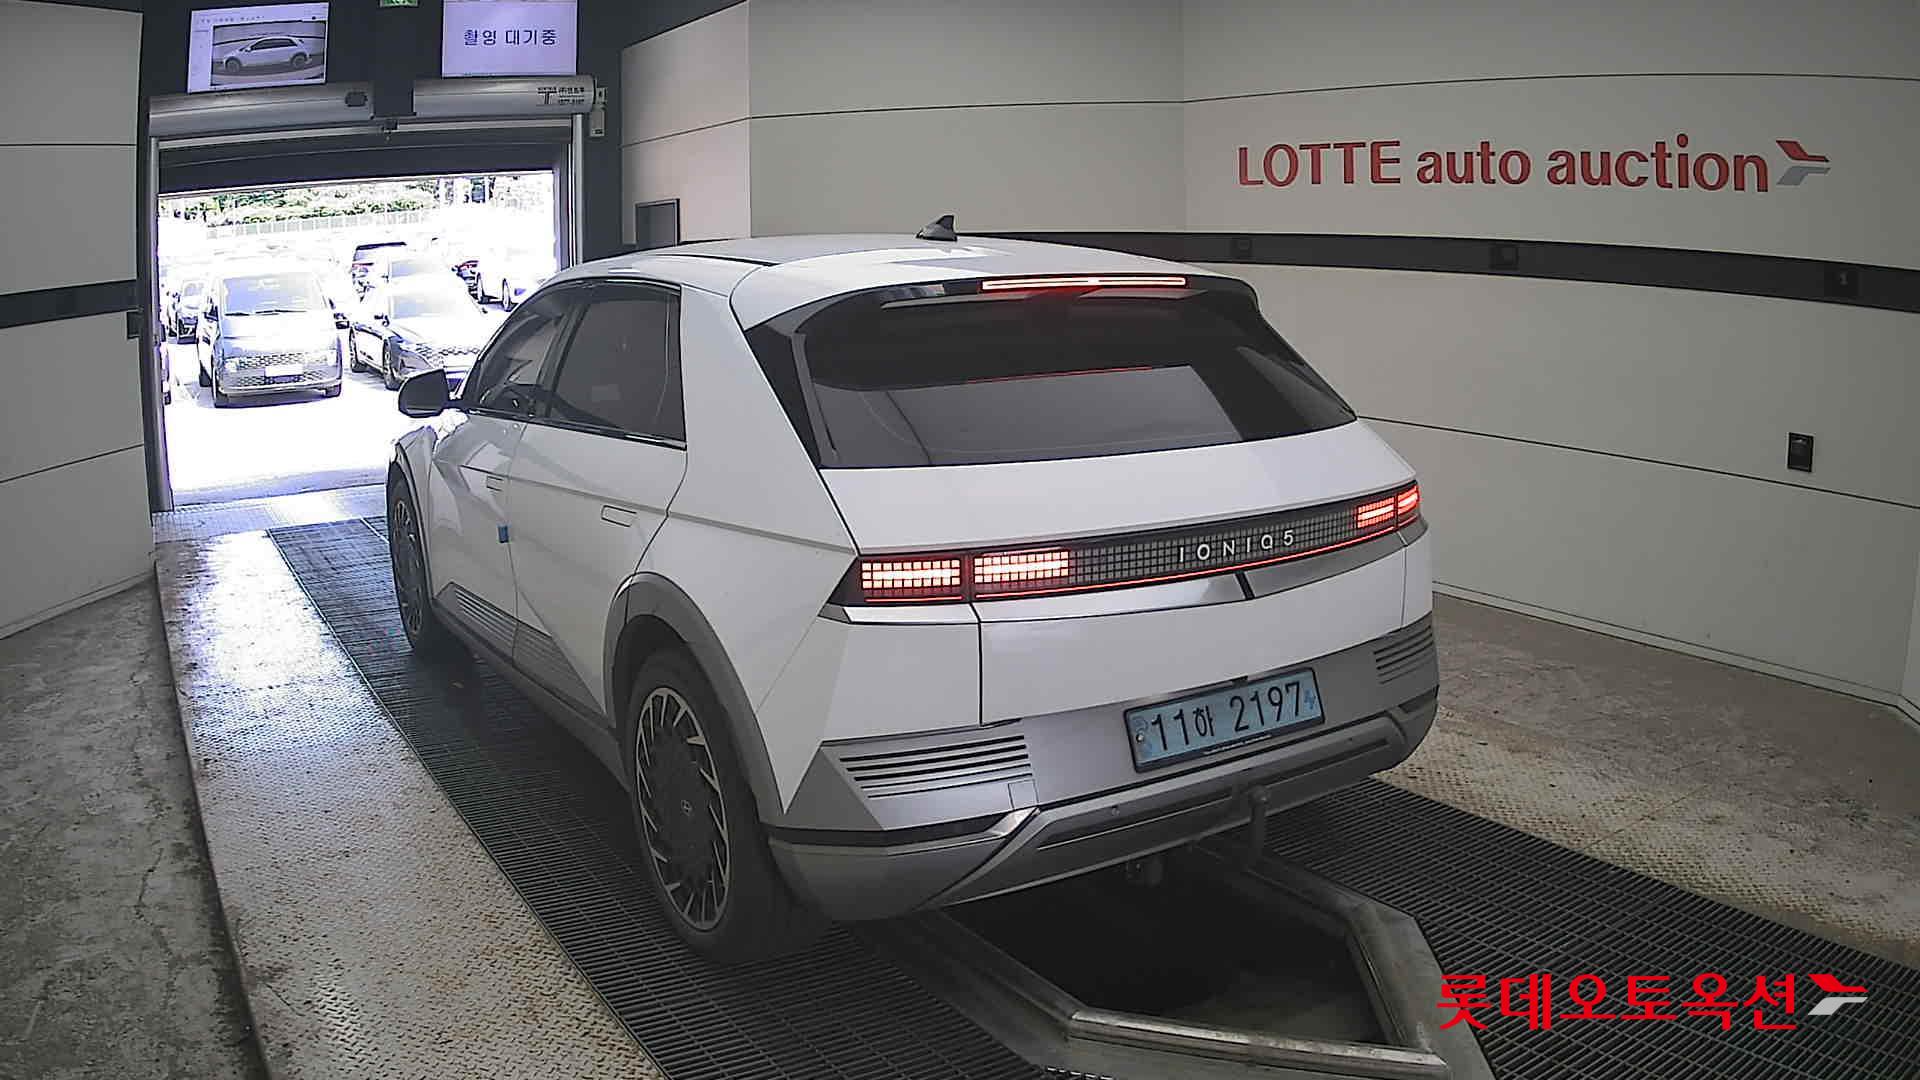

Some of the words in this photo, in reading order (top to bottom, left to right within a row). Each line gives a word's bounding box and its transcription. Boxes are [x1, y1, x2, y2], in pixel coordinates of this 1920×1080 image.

[505, 29, 557, 46] 대기중
[1238, 141, 1401, 186] LOTTE
[1416, 140, 1532, 184] auto
[1547, 135, 1769, 192] auction
[1230, 681, 1301, 732] 2197
